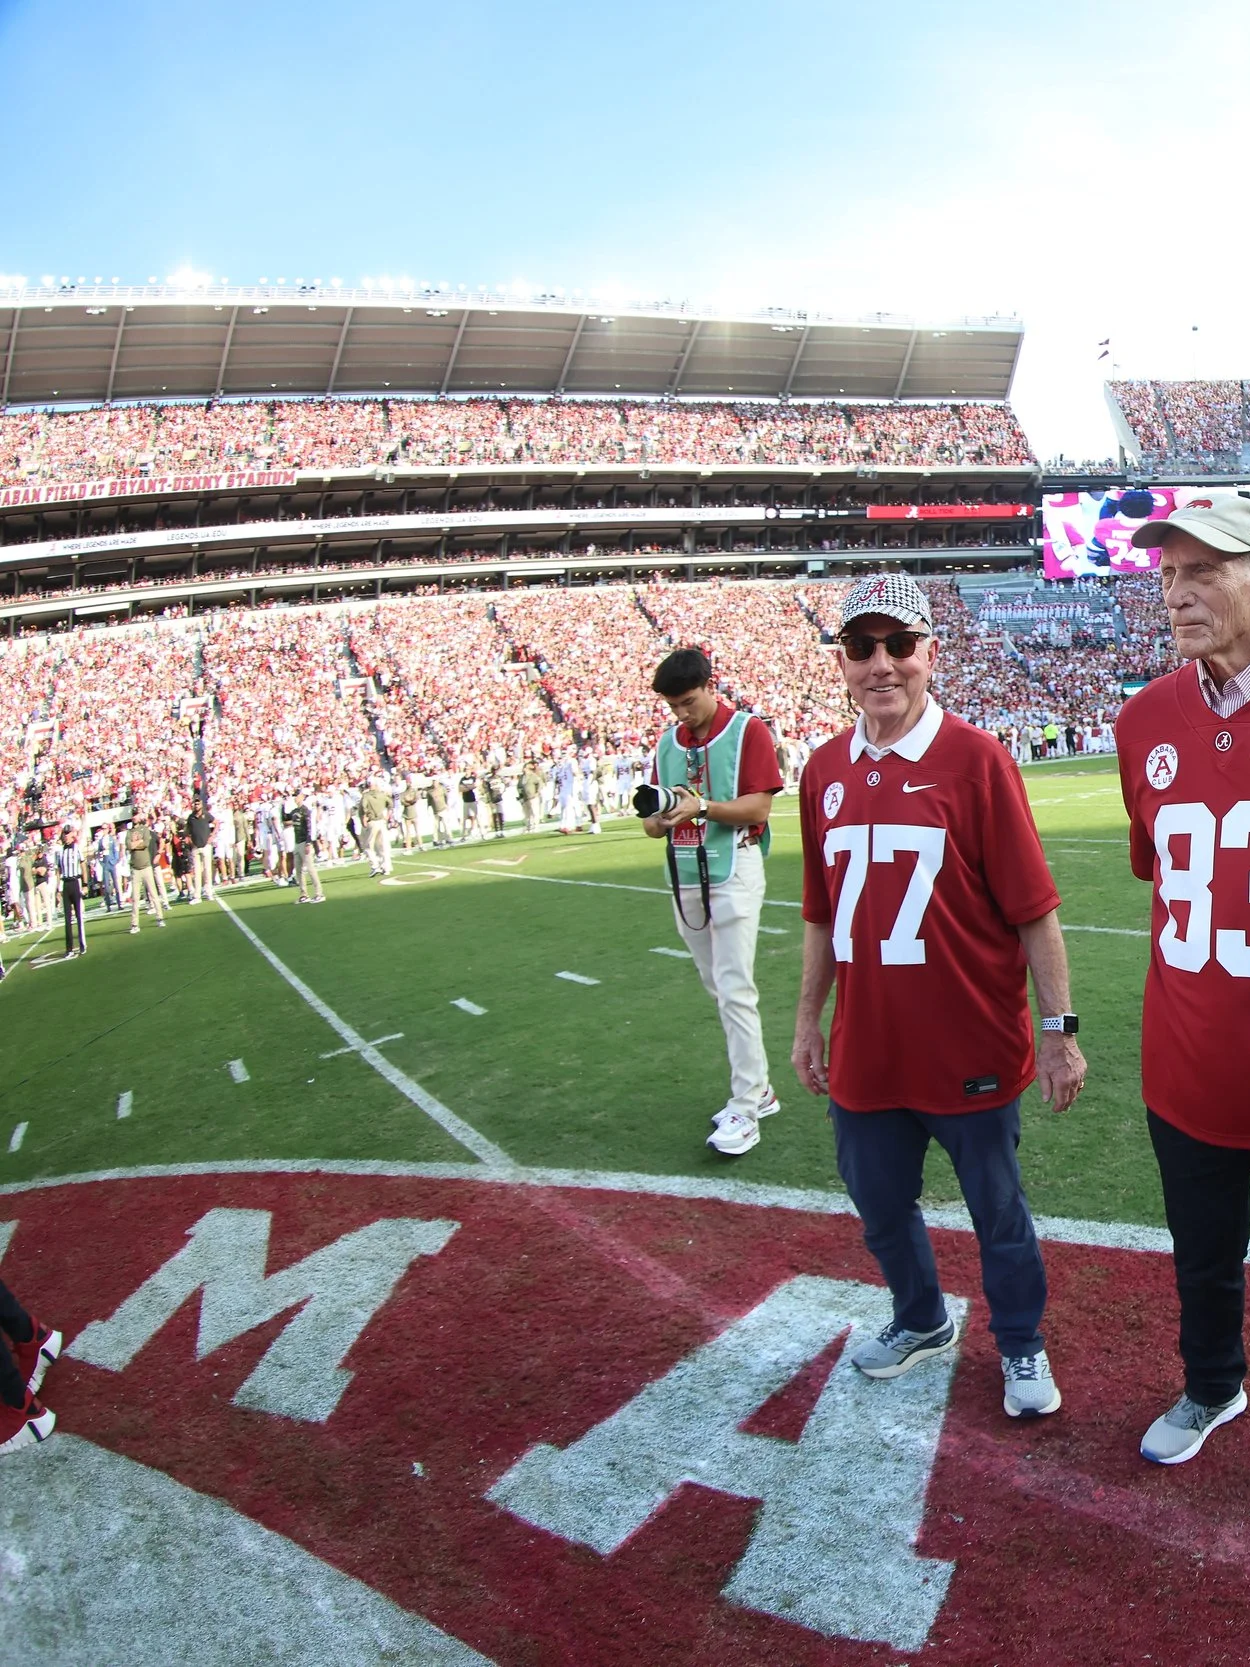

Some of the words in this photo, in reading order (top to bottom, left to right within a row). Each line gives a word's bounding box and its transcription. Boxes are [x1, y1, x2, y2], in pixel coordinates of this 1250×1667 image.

[0, 488, 41, 506] ABAN
[45, 484, 87, 502] FIELD
[90, 484, 105, 496] AT
[108, 475, 222, 496] BRYANT-DENNY
[226, 471, 295, 487] STADIUM
[83, 541, 107, 549] LEGENDS
[860, 580, 887, 602] A
[1148, 745, 1177, 765] ALABAMA
[1152, 755, 1172, 778] A
[1151, 776, 1173, 786] CLUB
[828, 791, 839, 810] A
[824, 824, 947, 966] 77
